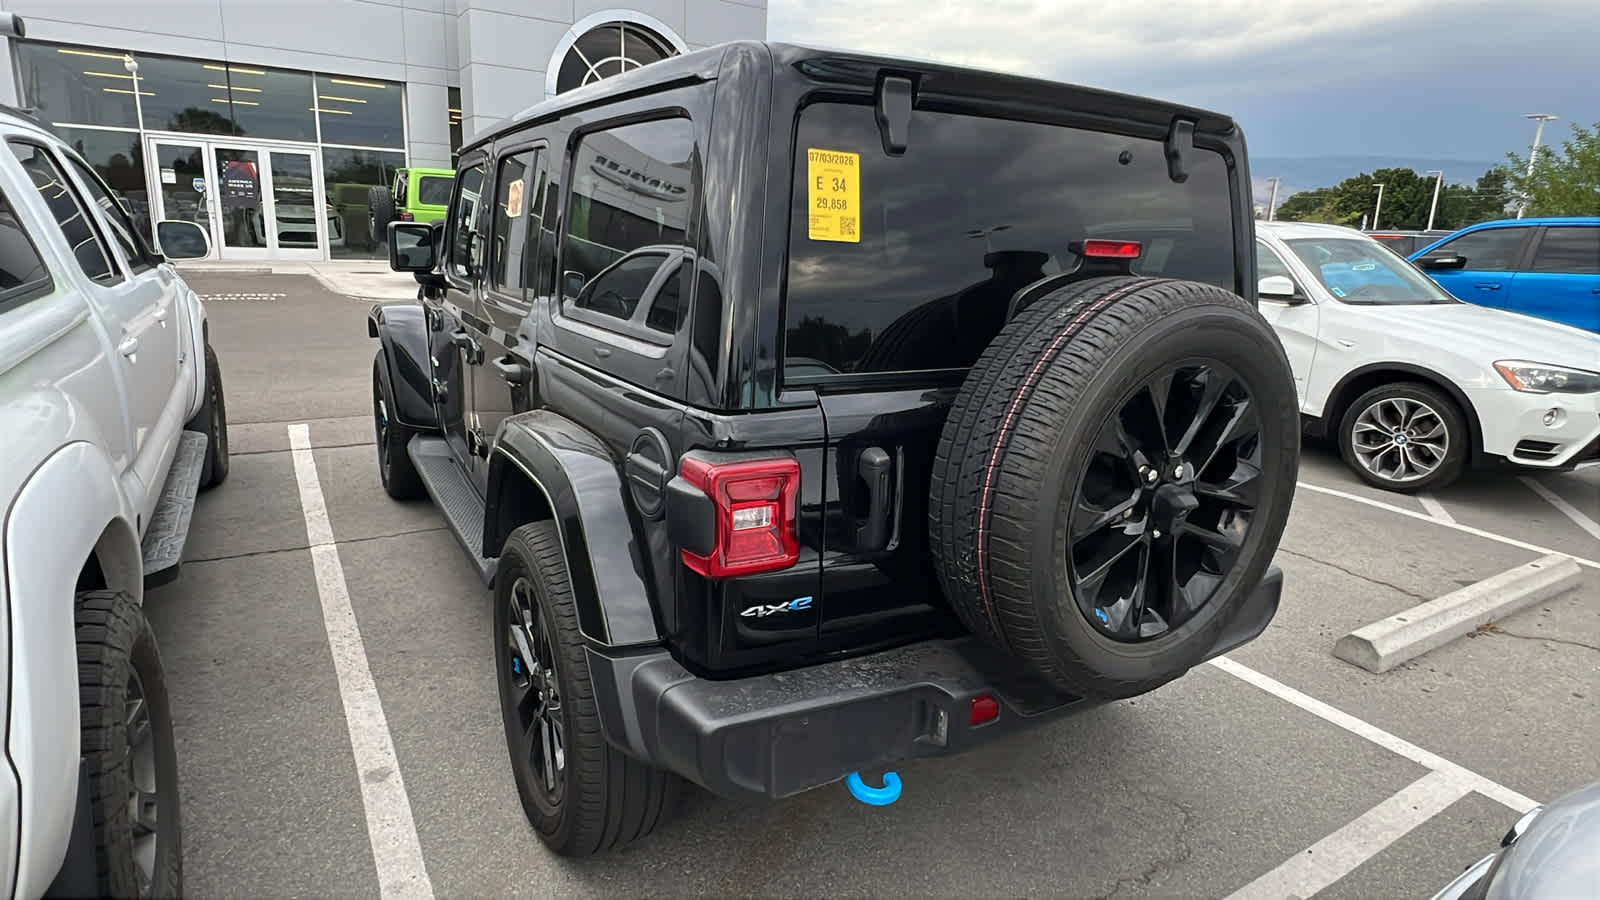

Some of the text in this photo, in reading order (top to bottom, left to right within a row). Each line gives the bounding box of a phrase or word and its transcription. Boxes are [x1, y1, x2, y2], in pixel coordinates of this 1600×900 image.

[809, 152, 853, 166] 07/03/2026
[816, 176, 846, 192] E 34
[816, 197, 847, 210] 29,858
